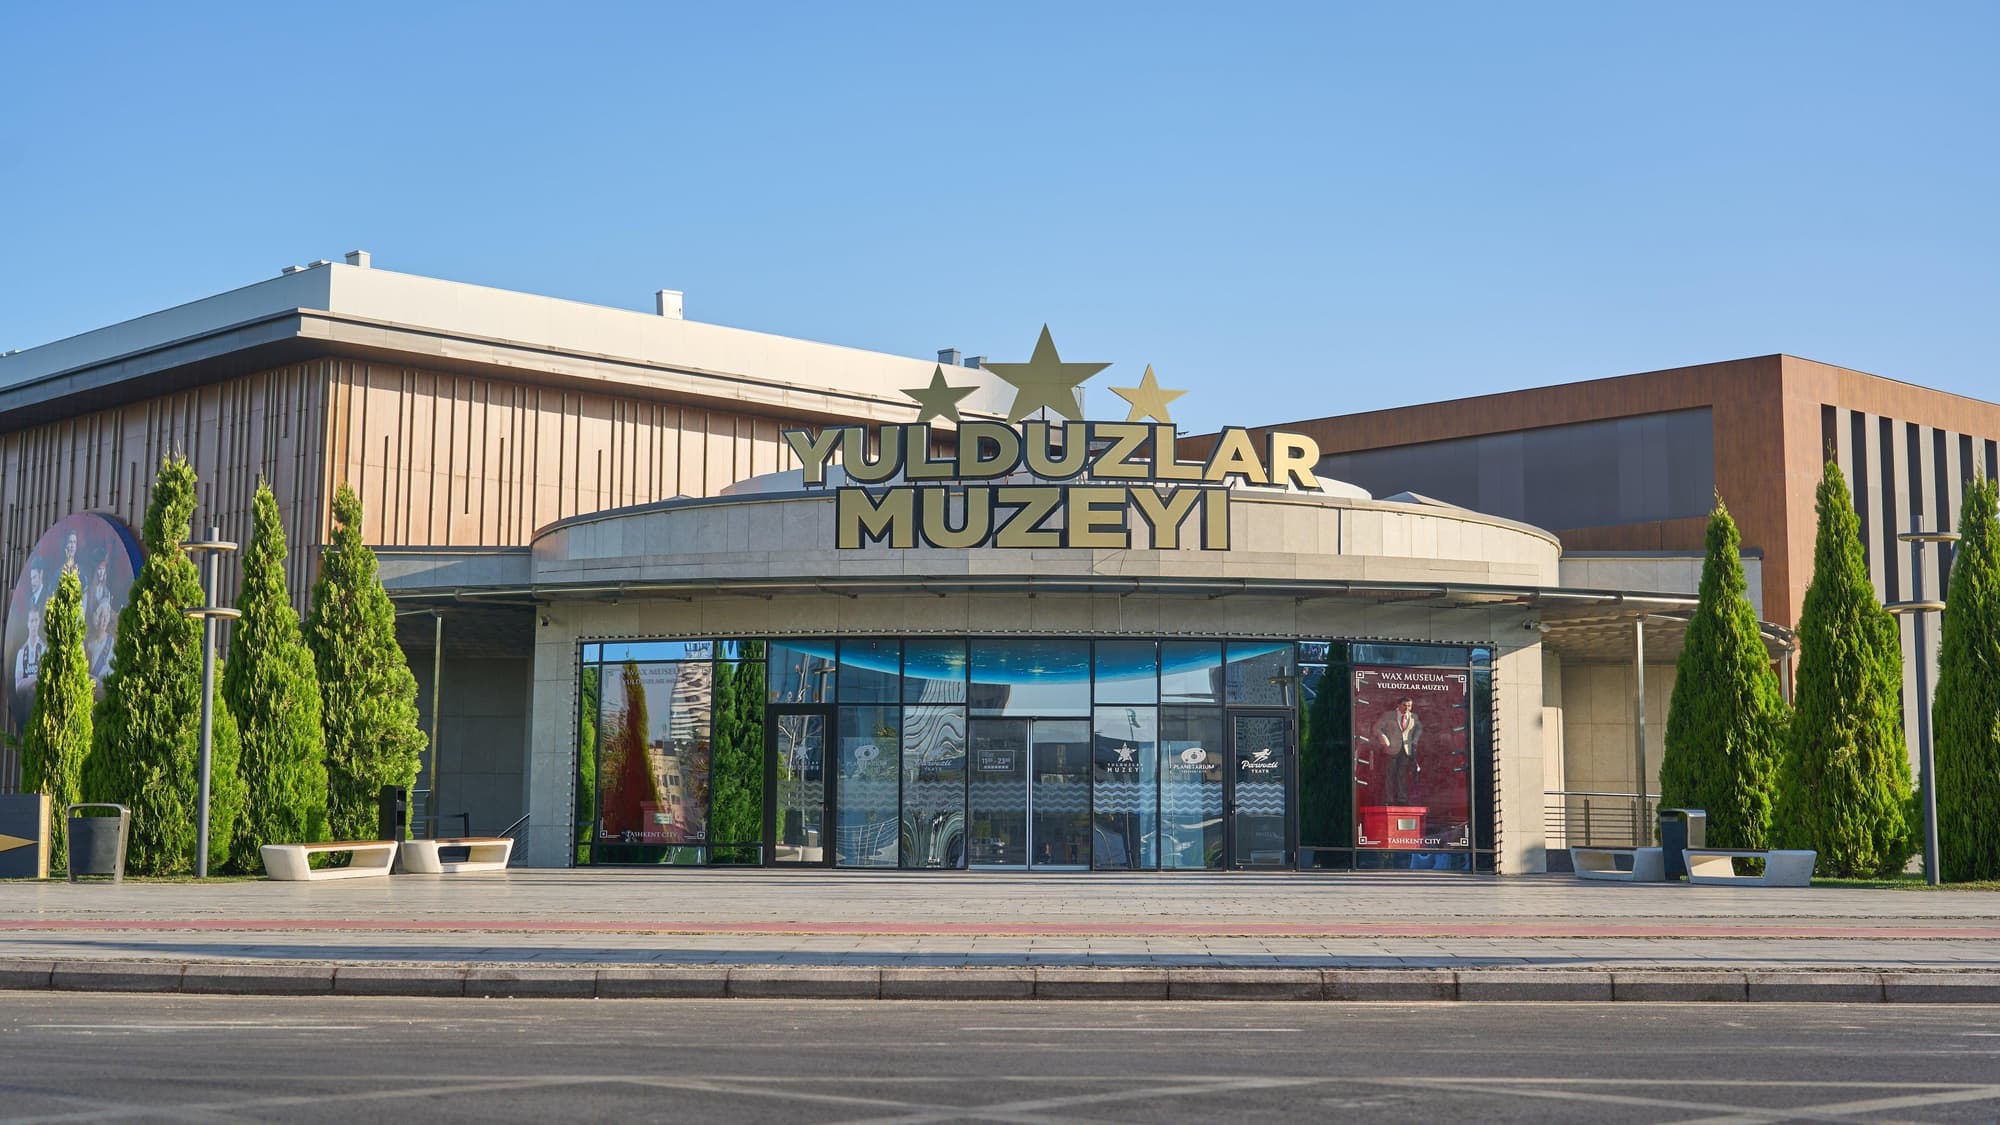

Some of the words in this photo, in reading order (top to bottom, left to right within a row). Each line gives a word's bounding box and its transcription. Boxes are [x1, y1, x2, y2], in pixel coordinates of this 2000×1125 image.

[783, 421, 1324, 491] YULDUZLAR
[836, 486, 1230, 551] MUZEYI
[1377, 682, 1420, 690] YULDUZLAR
[1381, 672, 1402, 681] WAX
[1404, 673, 1444, 682] MUSEUM
